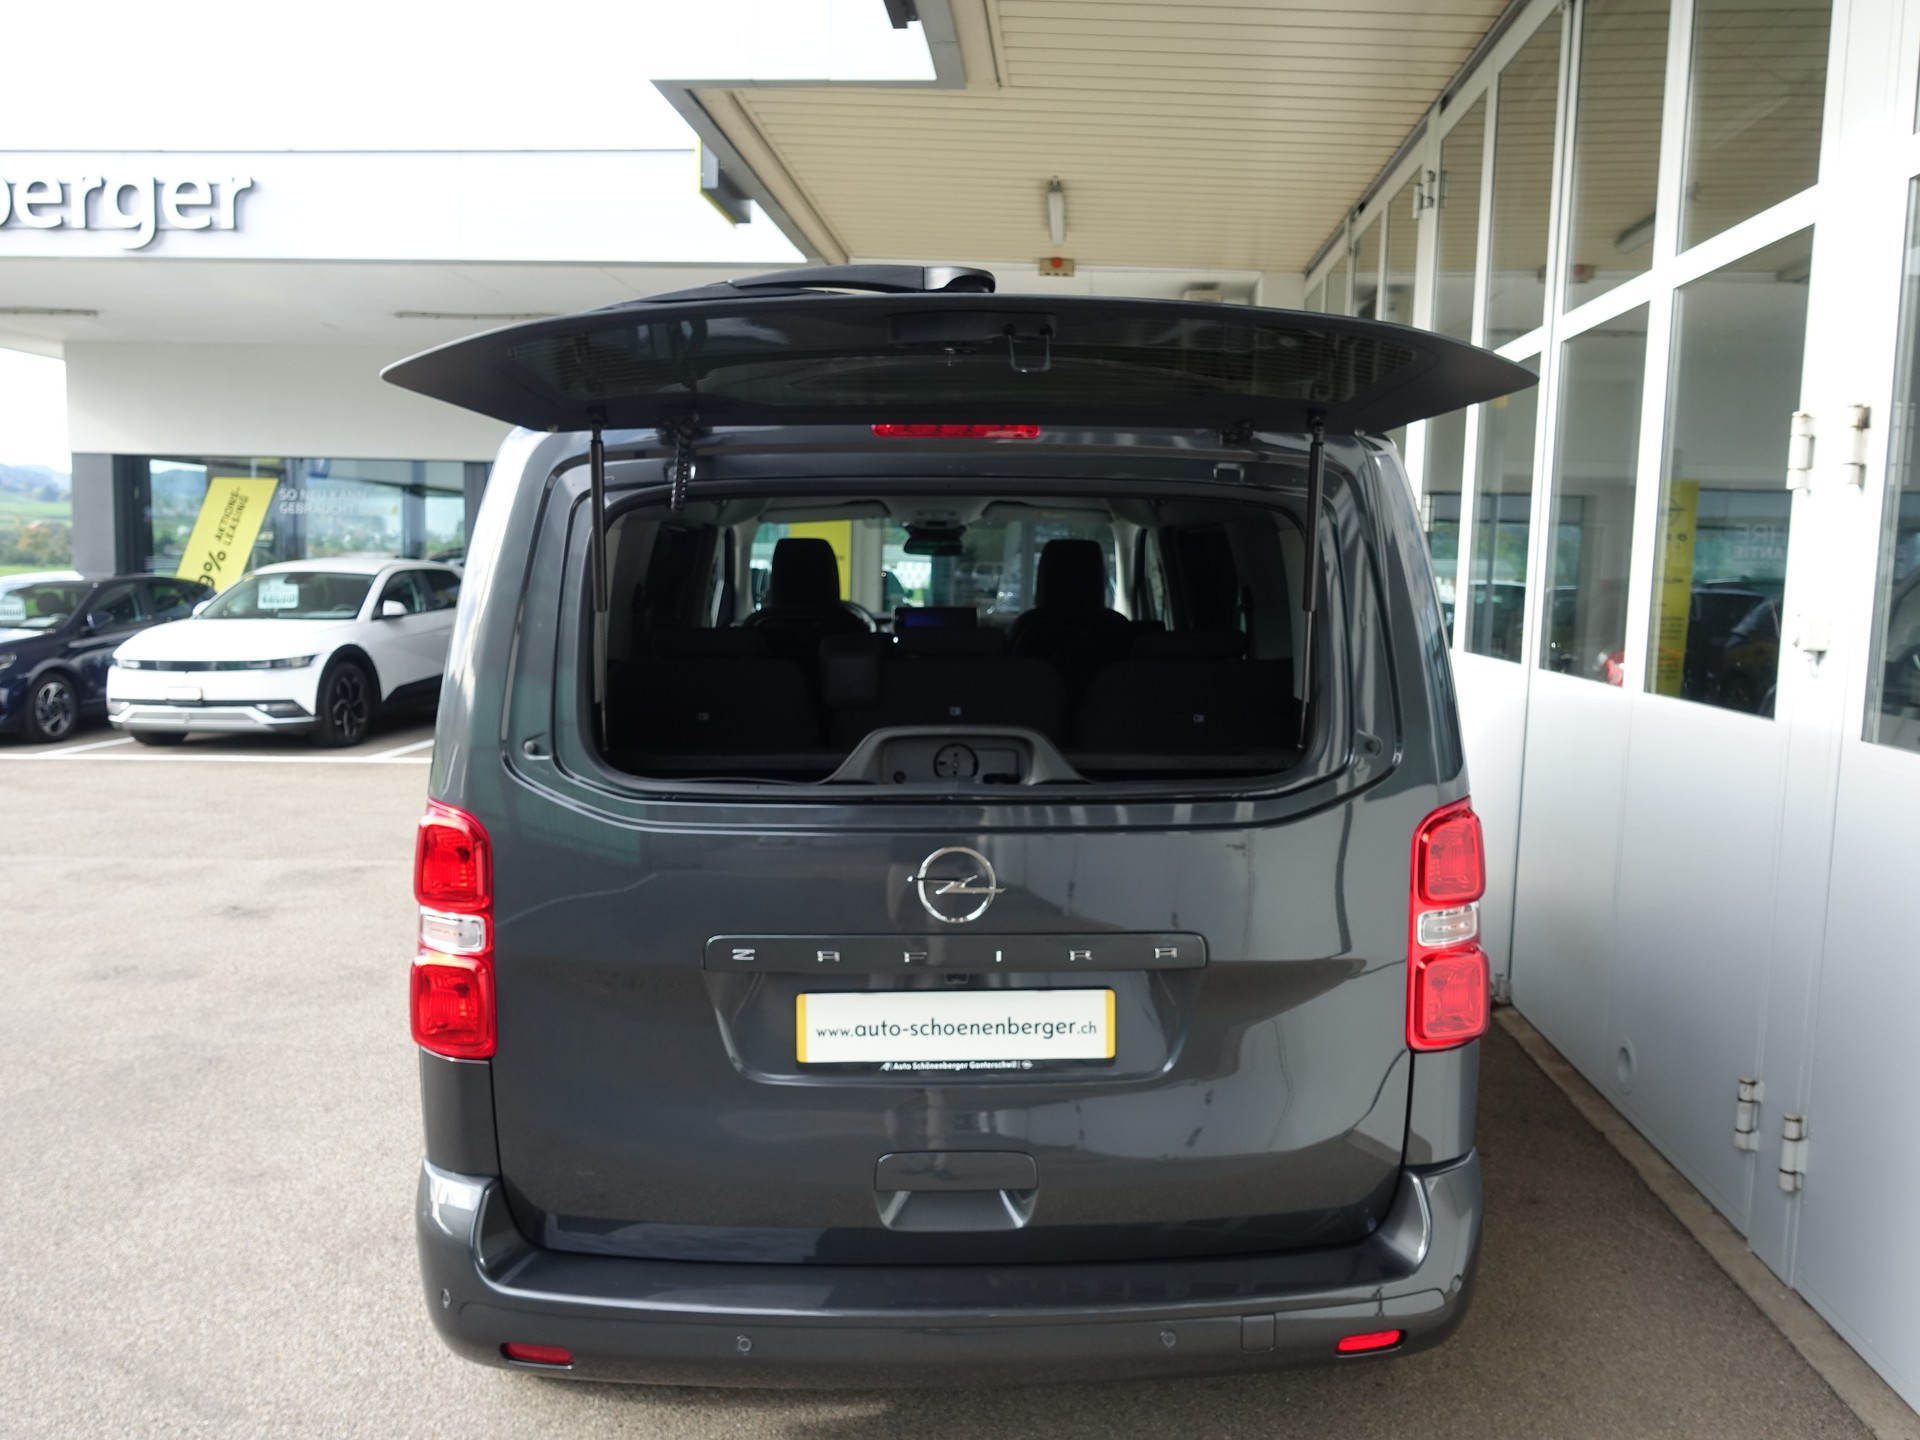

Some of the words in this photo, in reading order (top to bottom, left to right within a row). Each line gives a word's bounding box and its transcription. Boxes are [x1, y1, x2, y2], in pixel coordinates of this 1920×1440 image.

[0, 174, 253, 250] erger
[732, 948, 1177, 963] ZAFIRA
[816, 1017, 1098, 1040] www.auto-schoenenberger.ch
